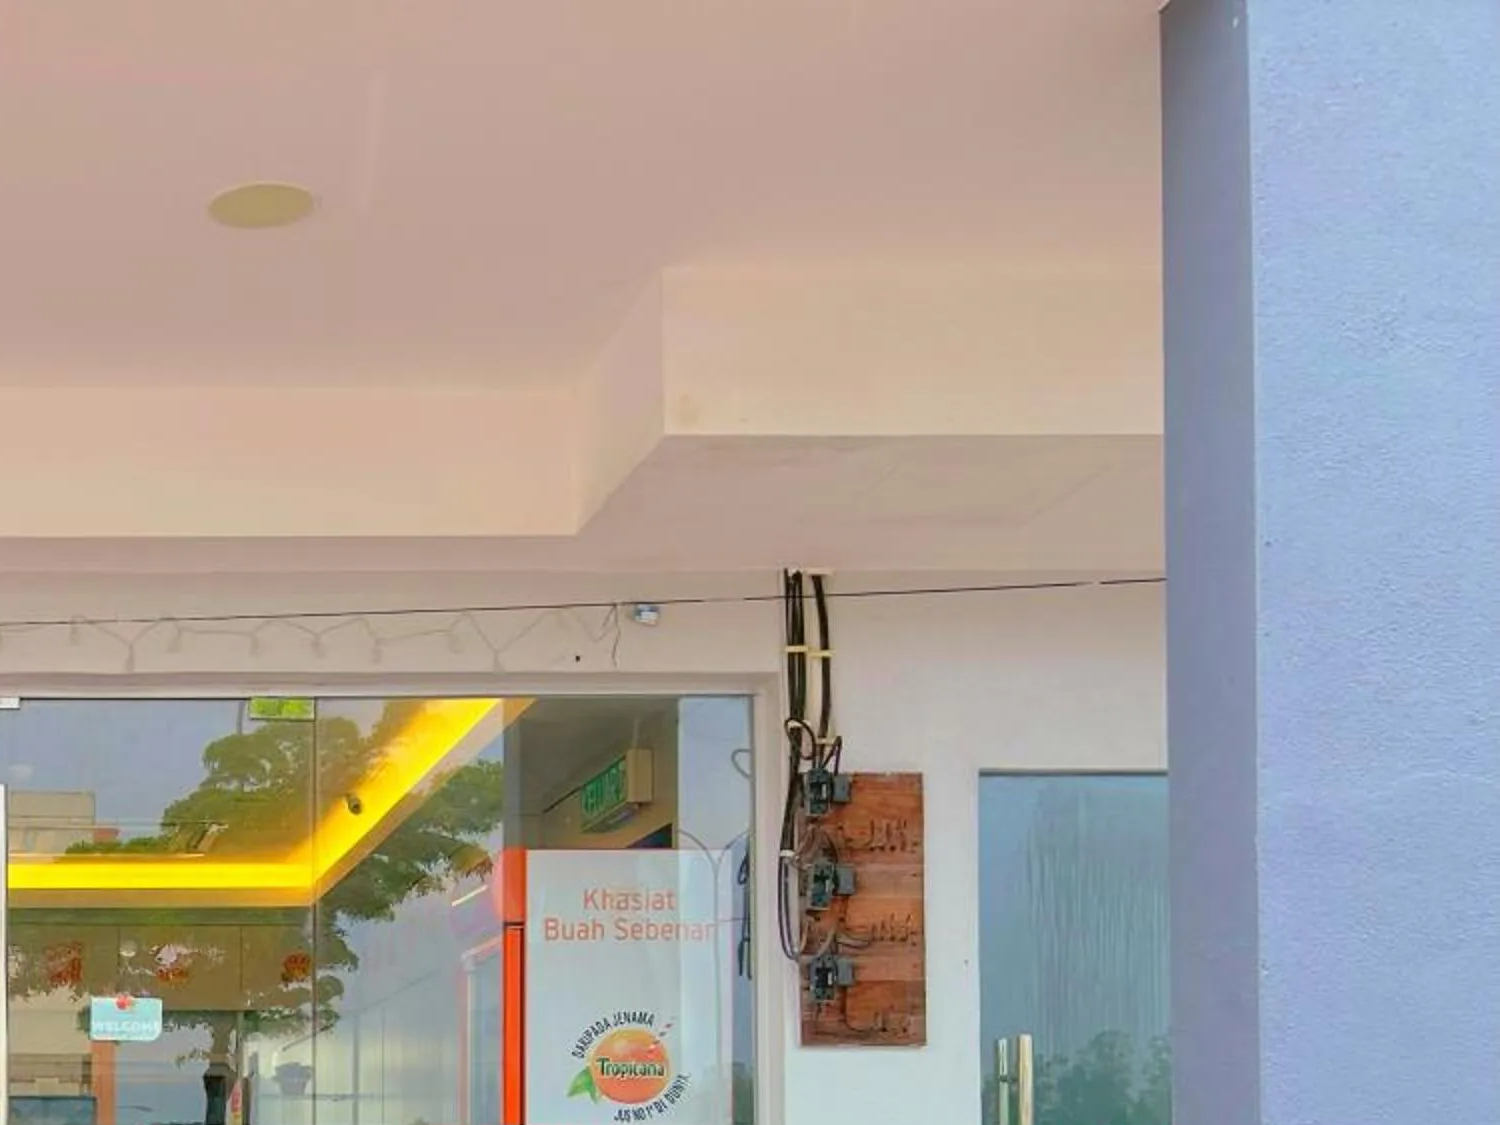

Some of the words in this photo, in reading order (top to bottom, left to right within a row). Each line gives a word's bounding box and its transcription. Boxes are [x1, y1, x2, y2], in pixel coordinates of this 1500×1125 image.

[583, 889, 677, 911] Khasiat
[544, 917, 605, 941] Buah
[614, 917, 715, 941] Sebenar
[595, 1057, 665, 1078] Tropicana
